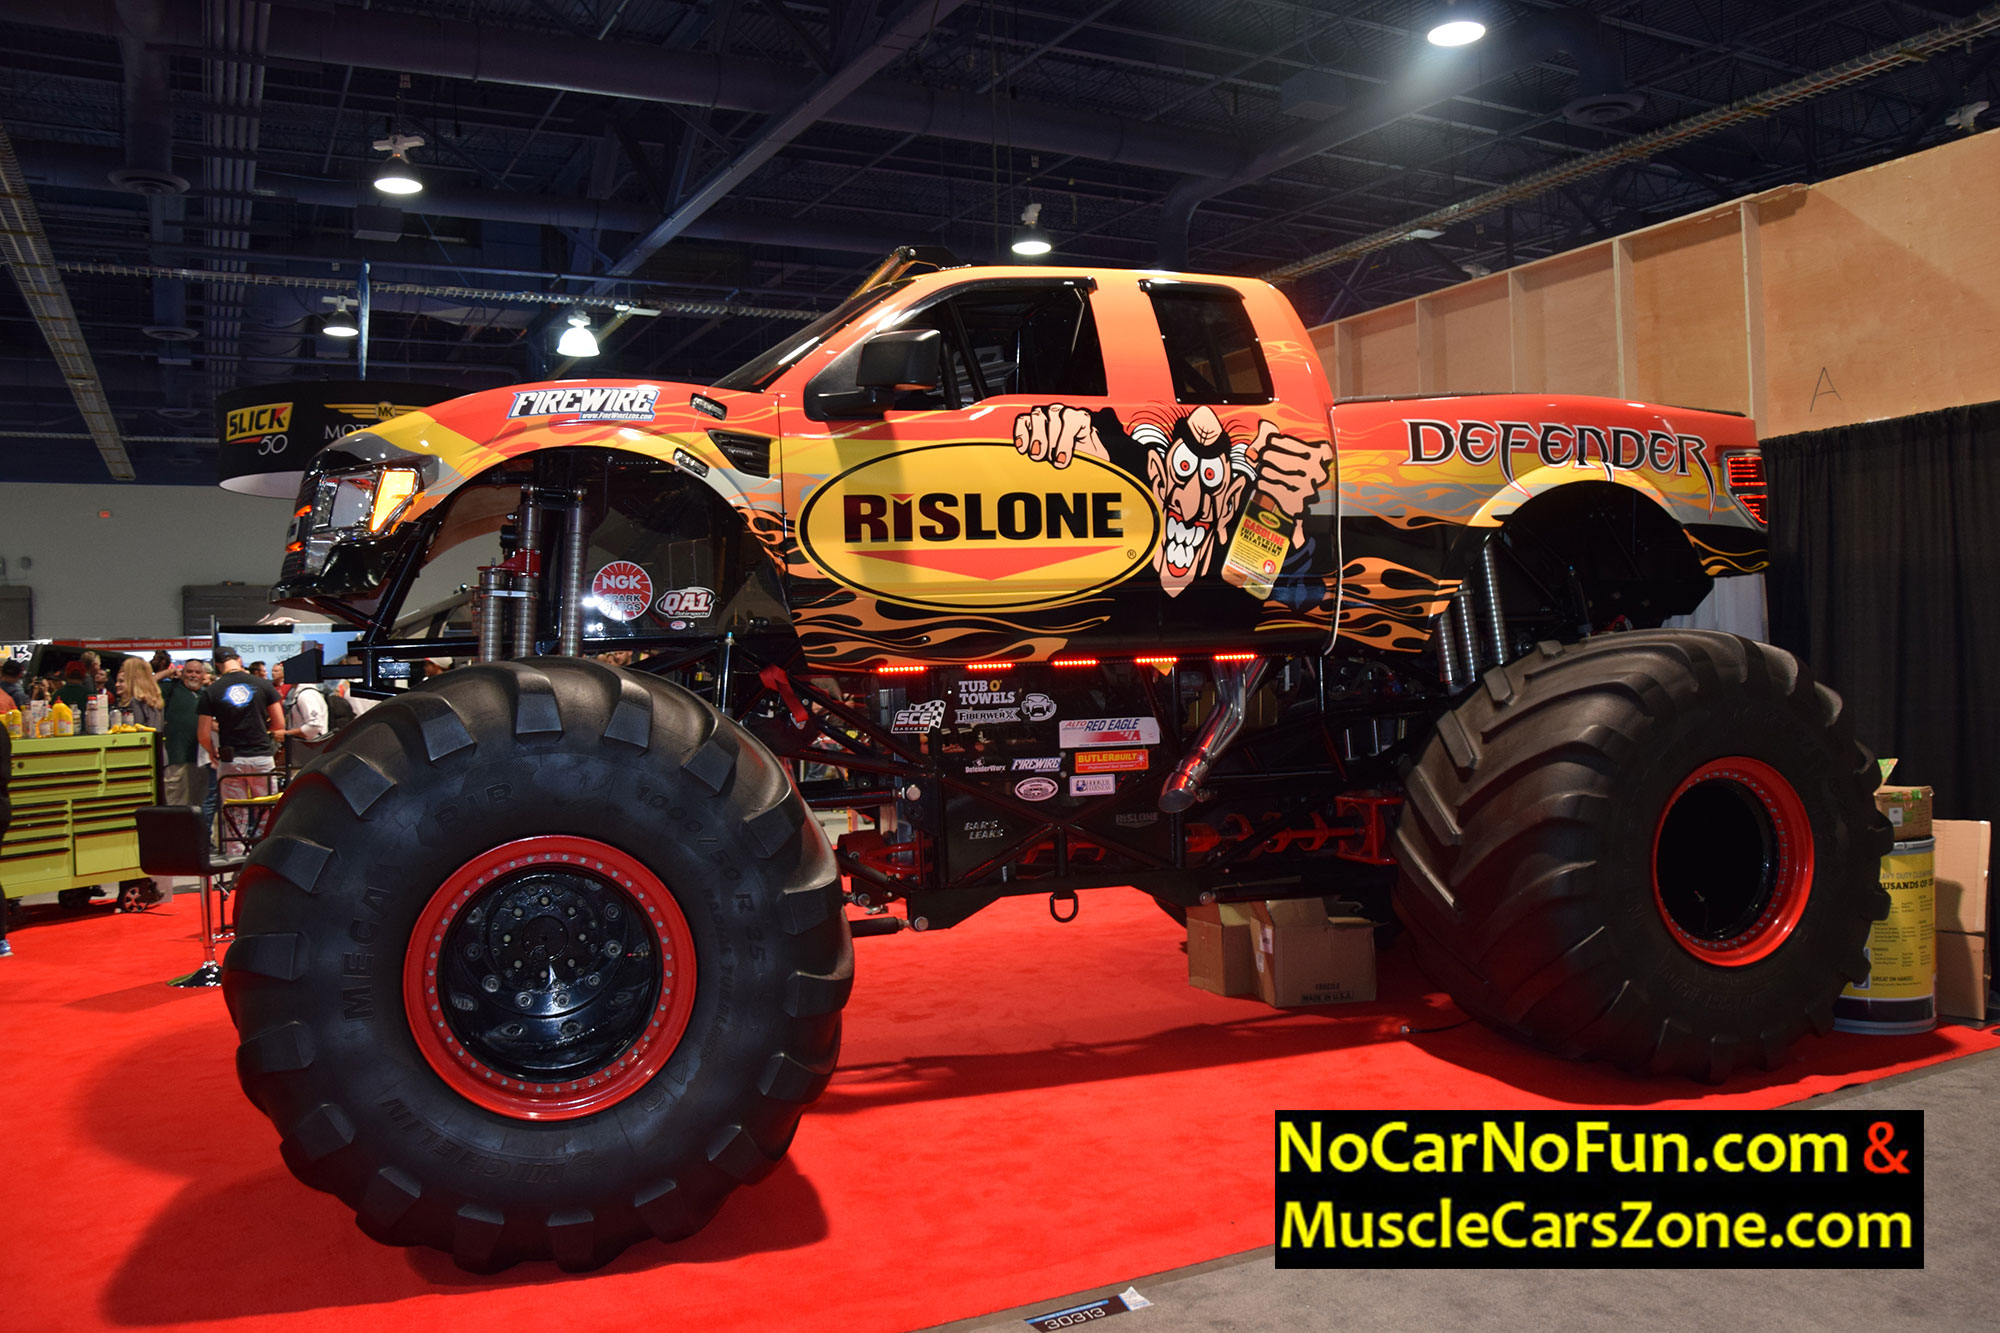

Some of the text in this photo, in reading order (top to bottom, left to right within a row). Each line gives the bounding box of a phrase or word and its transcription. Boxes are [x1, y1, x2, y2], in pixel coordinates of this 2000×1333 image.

[1809, 366, 1843, 413] A
[377, 406, 393, 417] MK
[511, 388, 658, 417] FIREWIRE
[228, 406, 287, 437] SLICK
[257, 434, 289, 456] 50
[1402, 418, 1717, 519] DEFENDER
[843, 491, 1124, 543] RISLONE
[1240, 532, 1281, 556] TREATMENT
[1241, 527, 1283, 551] FUEL SYSTEM
[1243, 518, 1286, 547] GASOLINE
[601, 575, 642, 590] NGK
[663, 592, 709, 615] QA1
[958, 680, 988, 693] TUB
[959, 691, 1016, 705] TOWELS
[896, 712, 932, 725] SCE
[1066, 720, 1087, 728] ALTO
[1085, 718, 1140, 732] RED EAGLE
[1011, 758, 1061, 771] FIREWIRE
[969, 829, 1004, 840] LEAKS
[342, 883, 395, 1024] MEGA
[380, 1096, 568, 1184] MICHELIN
[1044, 1307, 1106, 1330] 30313
